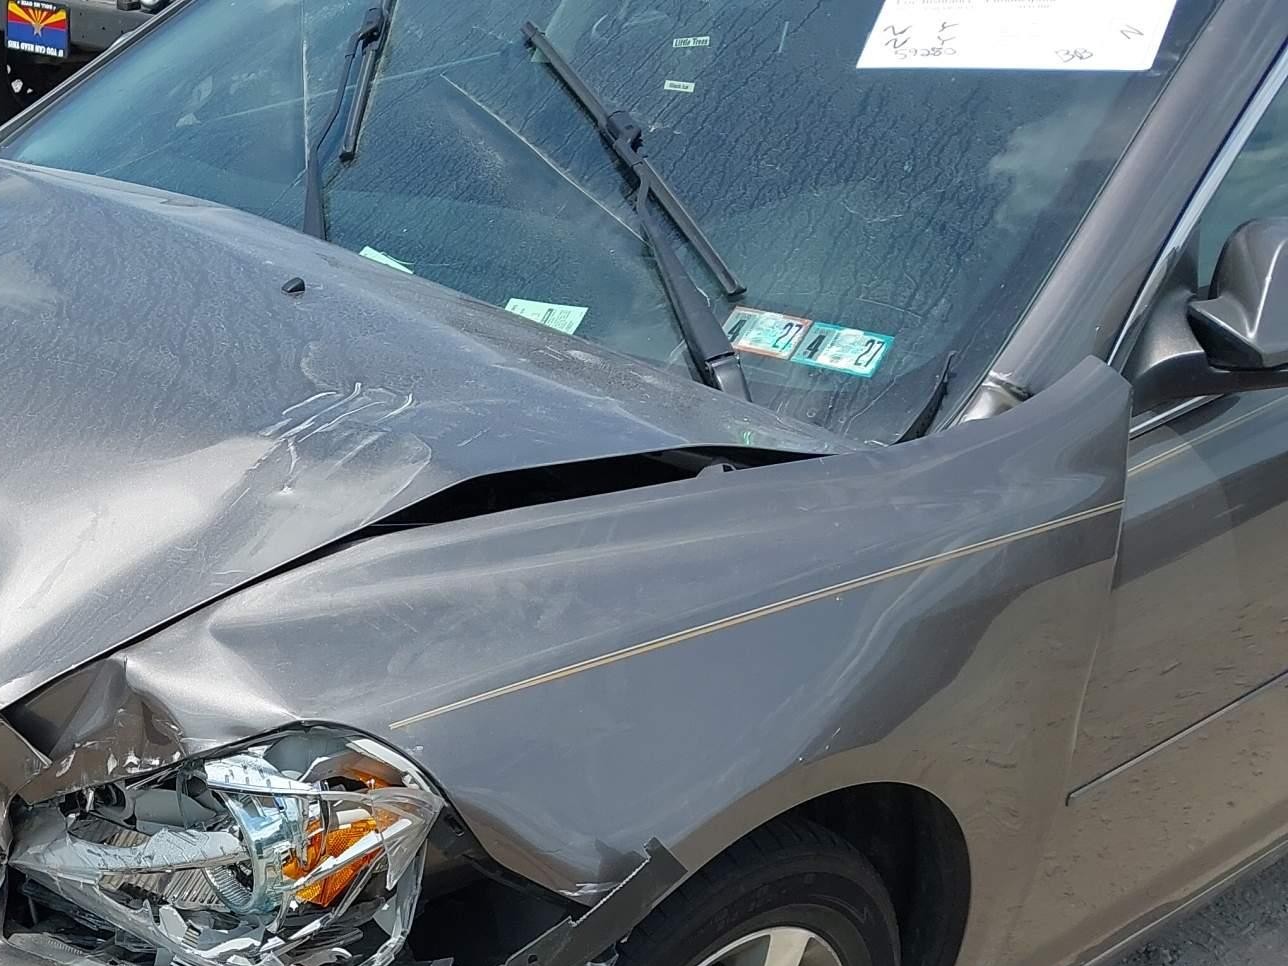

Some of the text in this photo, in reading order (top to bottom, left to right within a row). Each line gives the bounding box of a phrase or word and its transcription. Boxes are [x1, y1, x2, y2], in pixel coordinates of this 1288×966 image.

[8, 40, 20, 49] THIS
[21, 43, 34, 52] READ
[675, 39, 691, 47] Little
[35, 45, 46, 54] CAN
[47, 46, 57, 56] YOU
[727, 319, 803, 351] 4 27
[806, 334, 885, 368] 4 27
